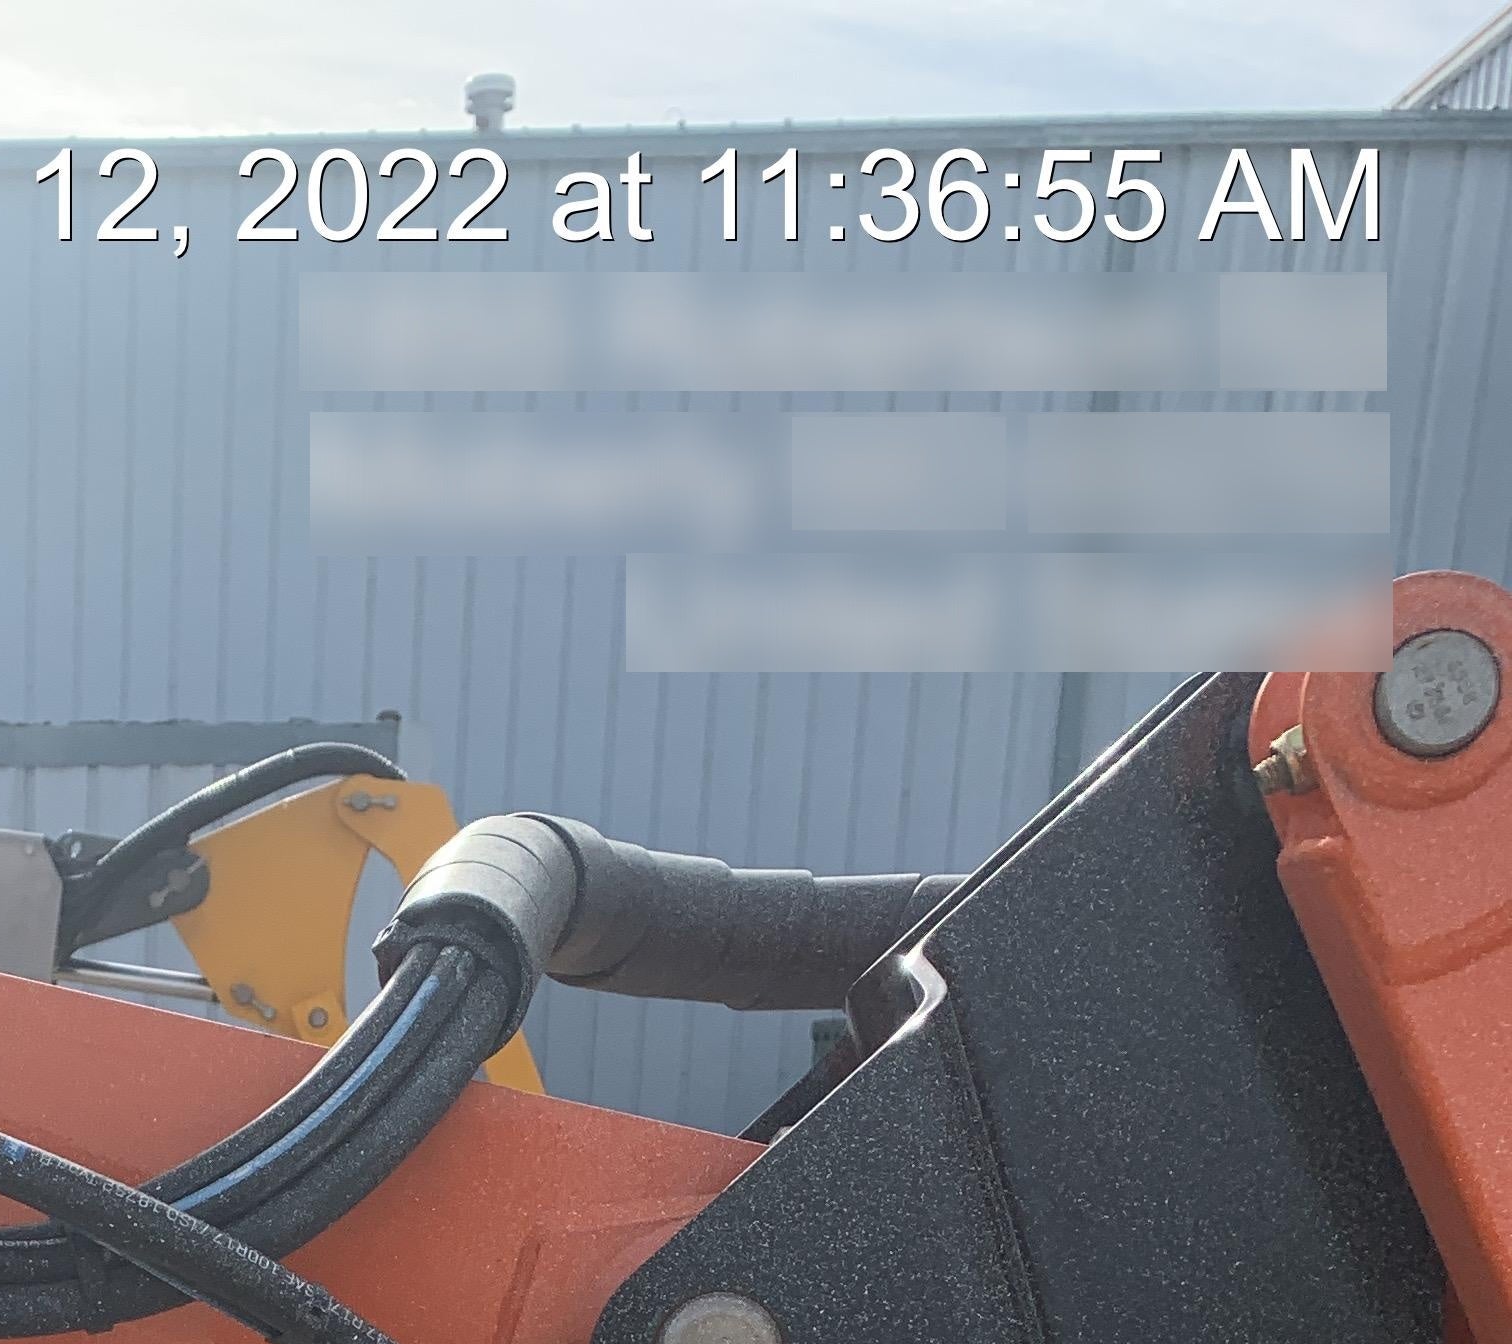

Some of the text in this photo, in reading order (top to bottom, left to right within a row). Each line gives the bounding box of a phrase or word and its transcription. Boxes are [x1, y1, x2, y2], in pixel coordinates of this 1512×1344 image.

[100, 1175, 162, 1214] 18752
[165, 1204, 200, 1233] ISO
[211, 1226, 282, 1279] 100R17
[329, 1300, 365, 1330] R17
